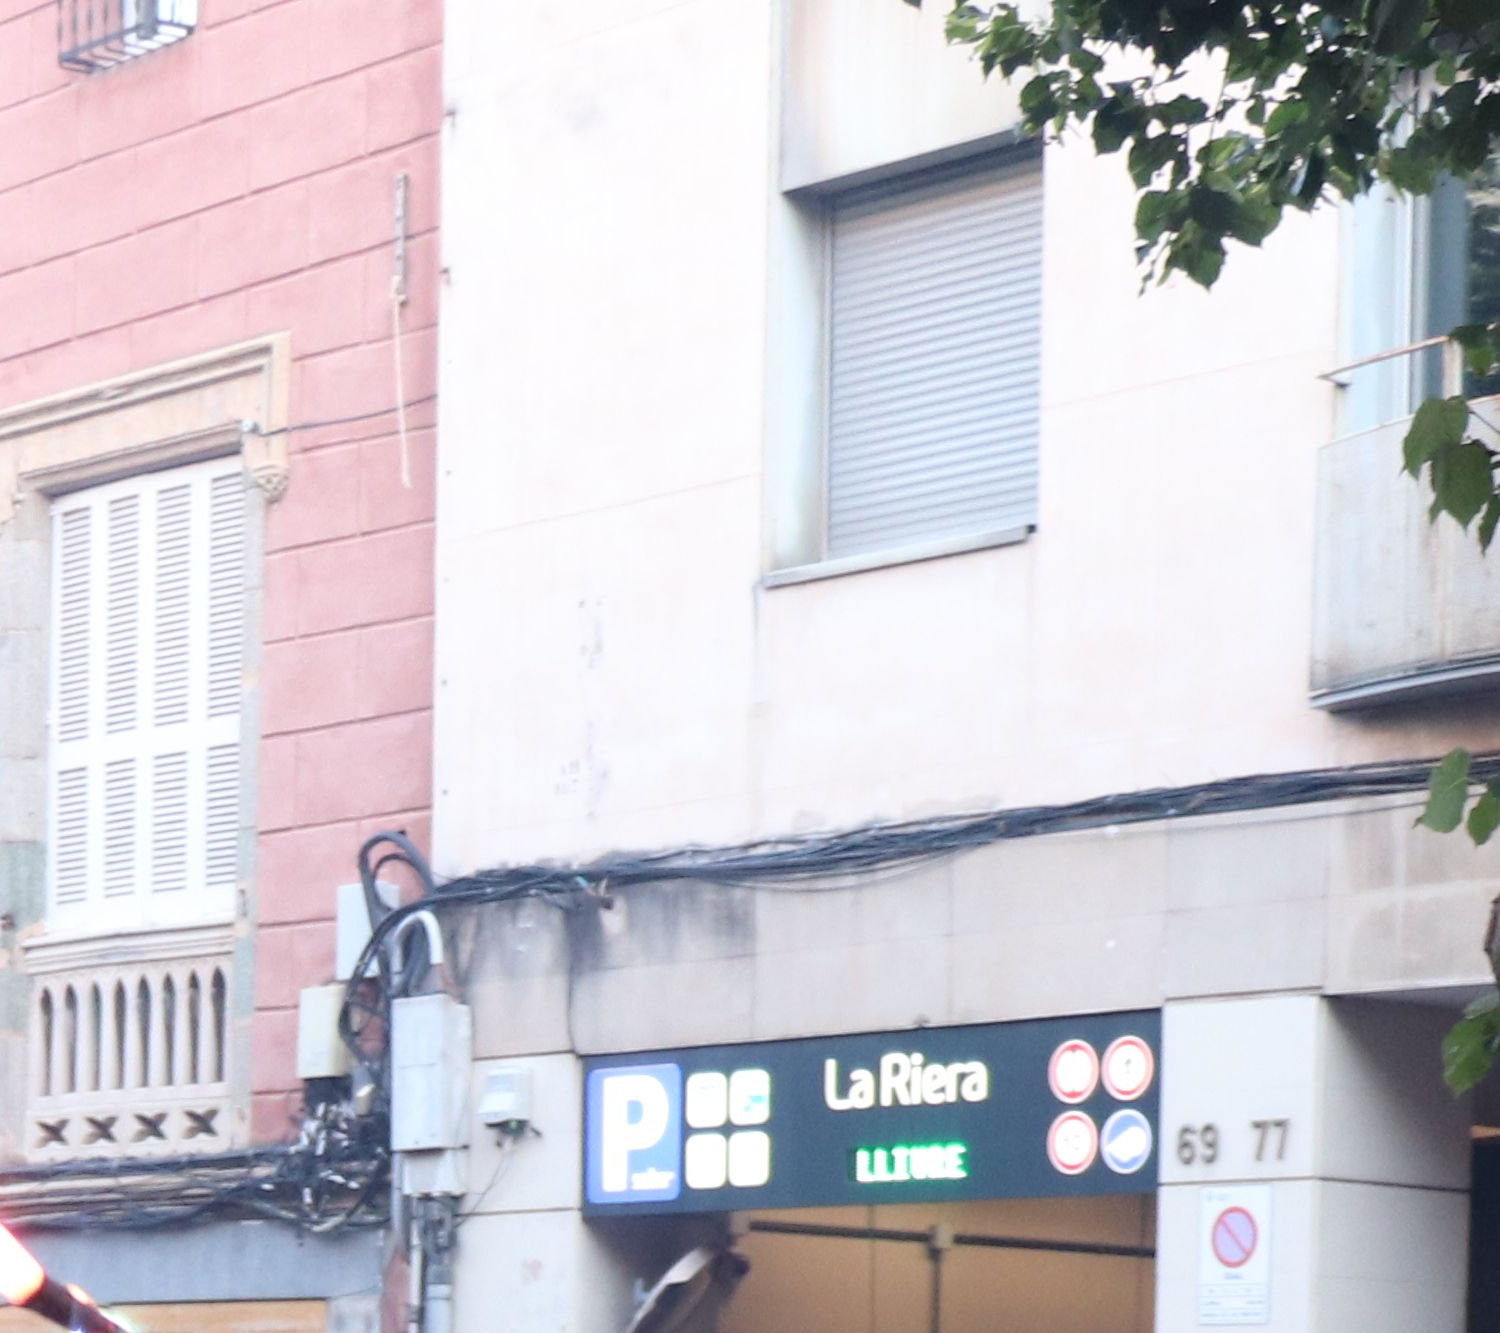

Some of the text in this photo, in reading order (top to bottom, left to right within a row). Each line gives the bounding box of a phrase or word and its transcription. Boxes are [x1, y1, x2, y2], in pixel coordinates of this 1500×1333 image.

[824, 1052, 988, 1111] La Riera
[602, 1074, 669, 1192] P
[1177, 1118, 1290, 1166] 69 77
